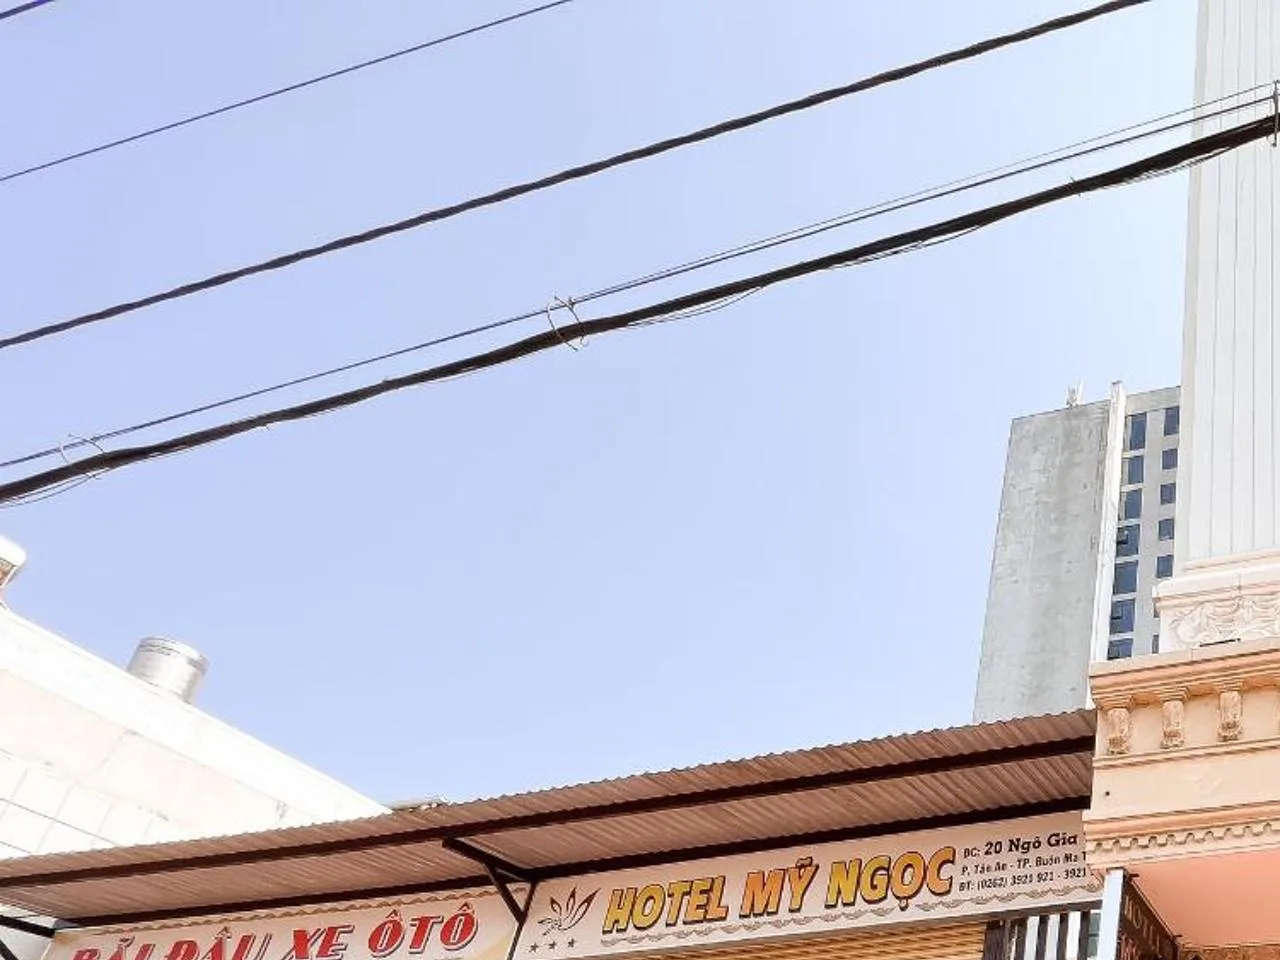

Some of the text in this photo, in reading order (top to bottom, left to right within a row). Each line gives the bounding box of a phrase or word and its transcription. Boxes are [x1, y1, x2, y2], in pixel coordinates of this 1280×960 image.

[985, 840, 1003, 856] 20
[1008, 835, 1042, 854] Ngô
[1047, 832, 1078, 847] Gia
[1017, 858, 1032, 870] TP.
[601, 846, 957, 934] HOTEL MỸ NGỌC
[368, 903, 480, 958] ÔTÔ
